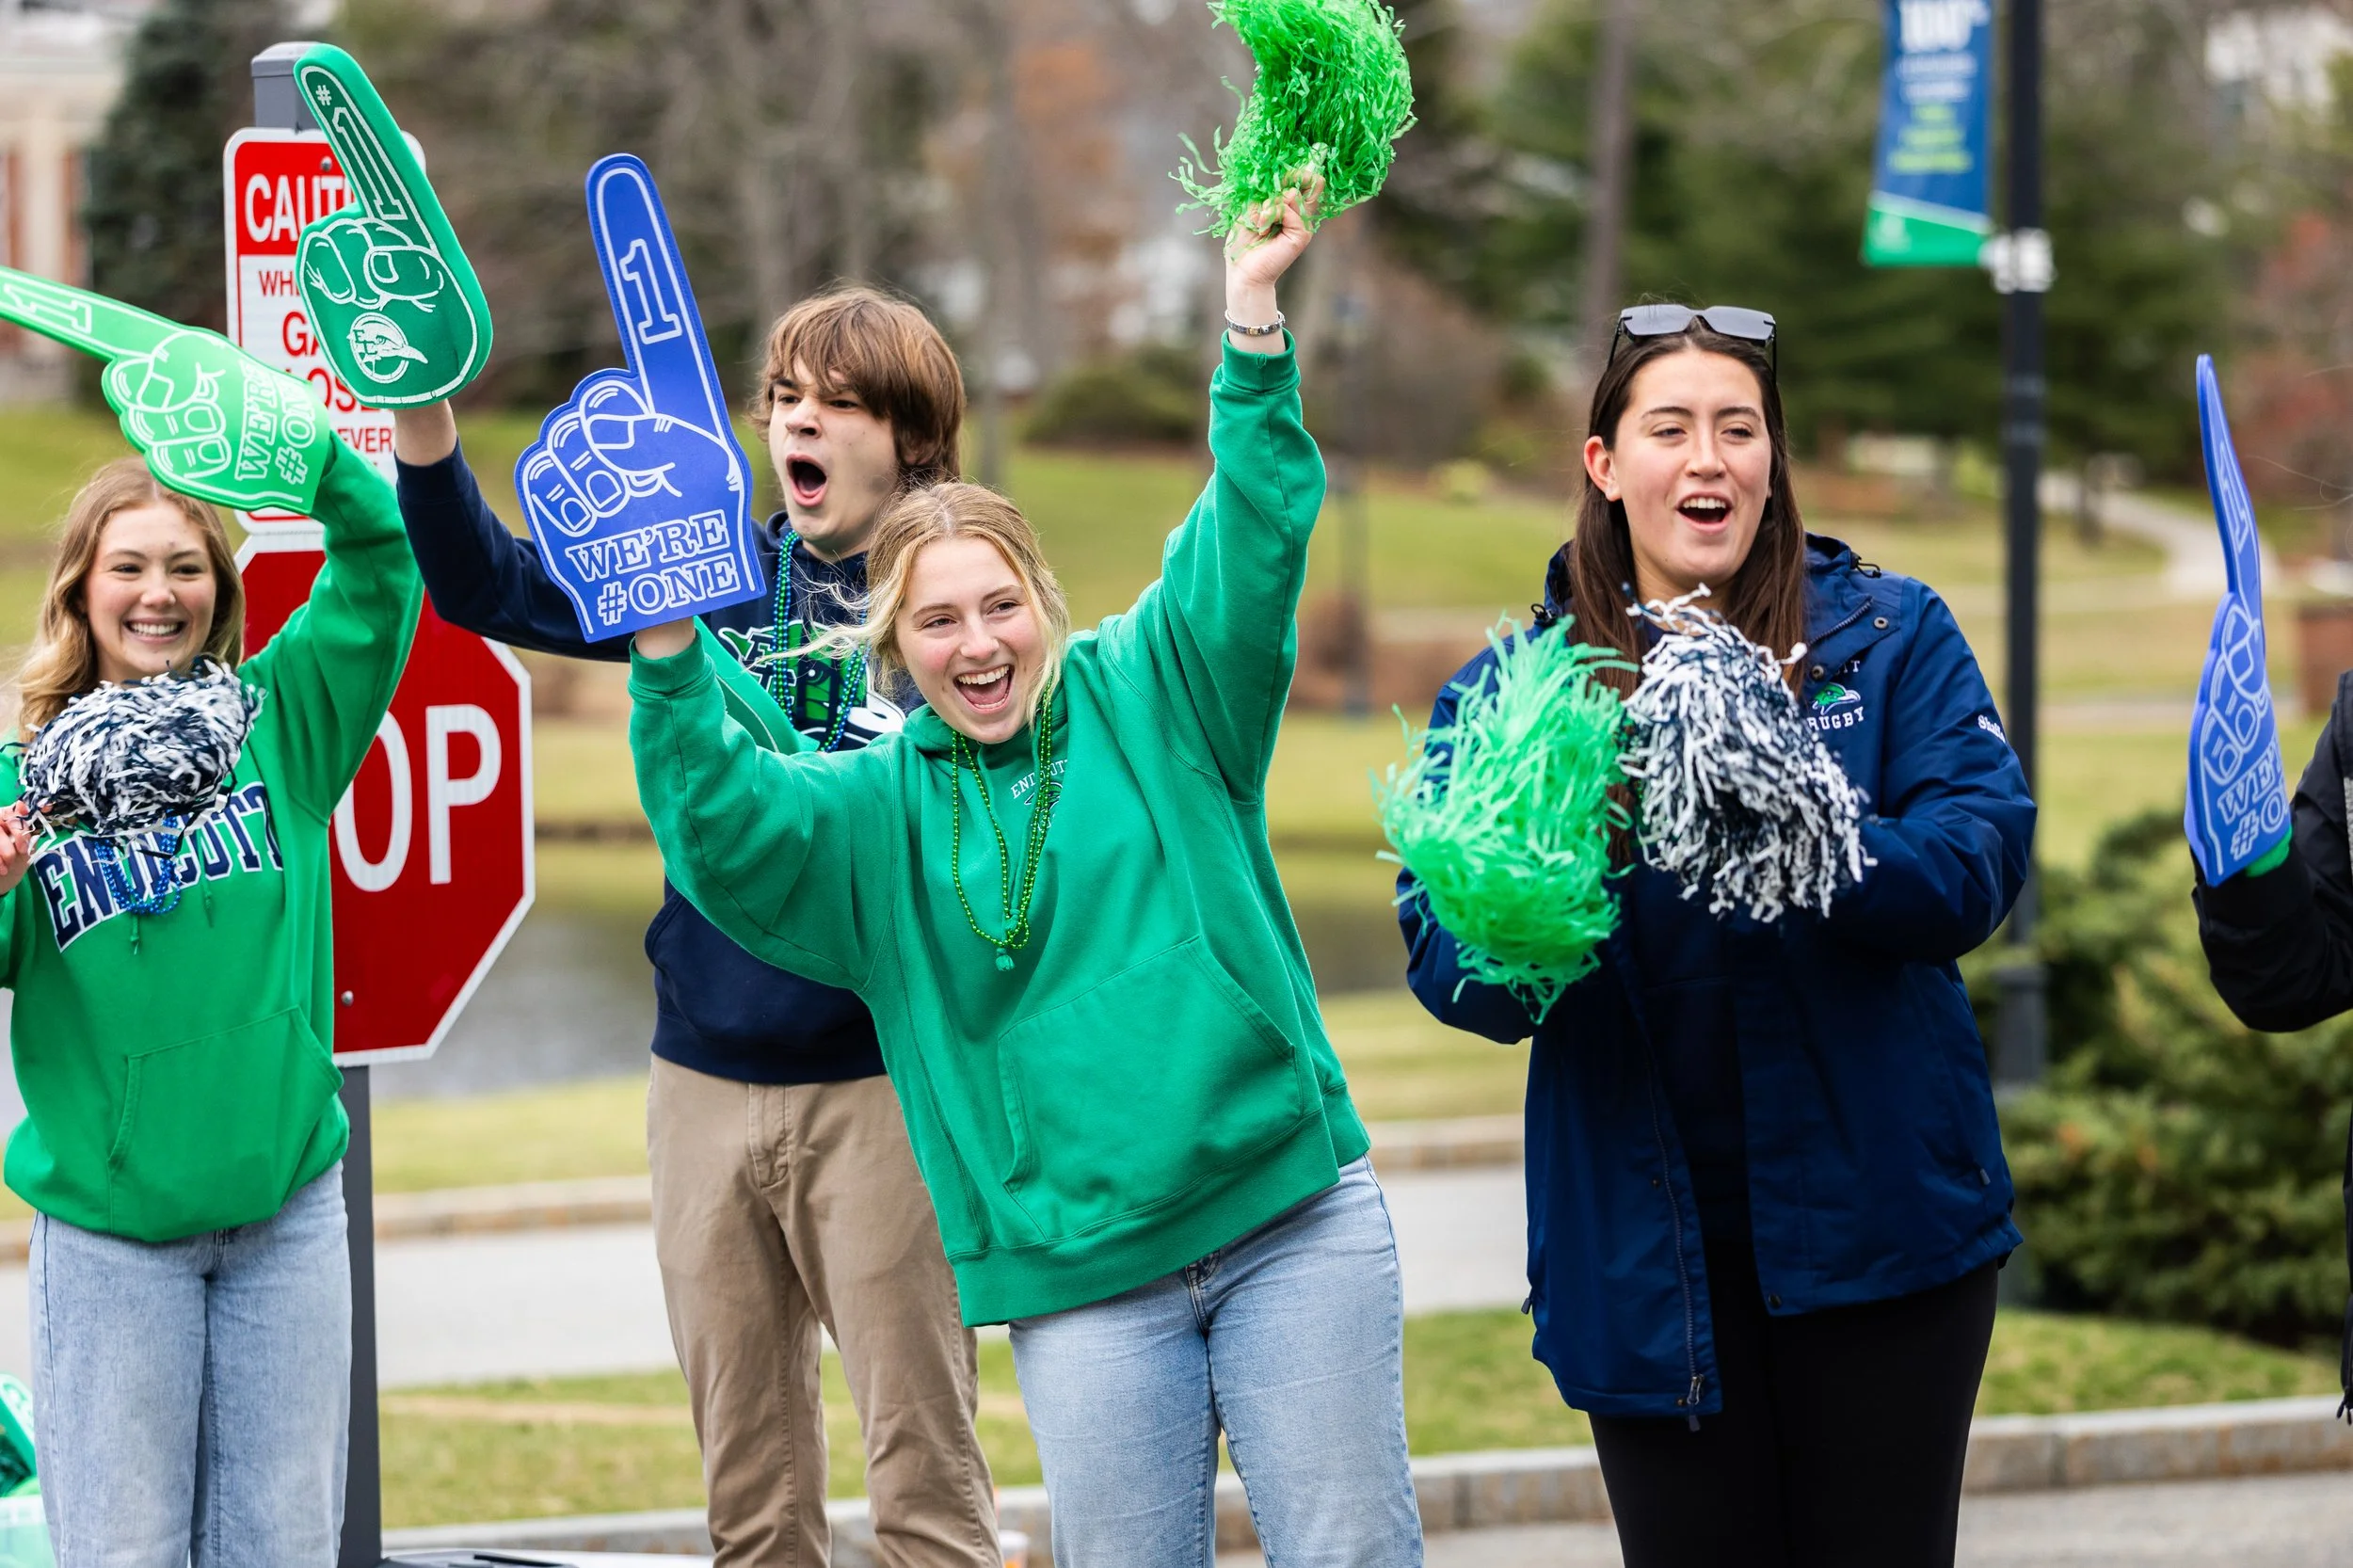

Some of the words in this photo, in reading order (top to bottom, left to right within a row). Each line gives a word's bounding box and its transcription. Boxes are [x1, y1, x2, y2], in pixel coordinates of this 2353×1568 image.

[619, 238, 683, 344] 1
[565, 509, 730, 583] WE'RE
[598, 552, 741, 627] #ONE
[1807, 706, 1865, 731] RUGBY
